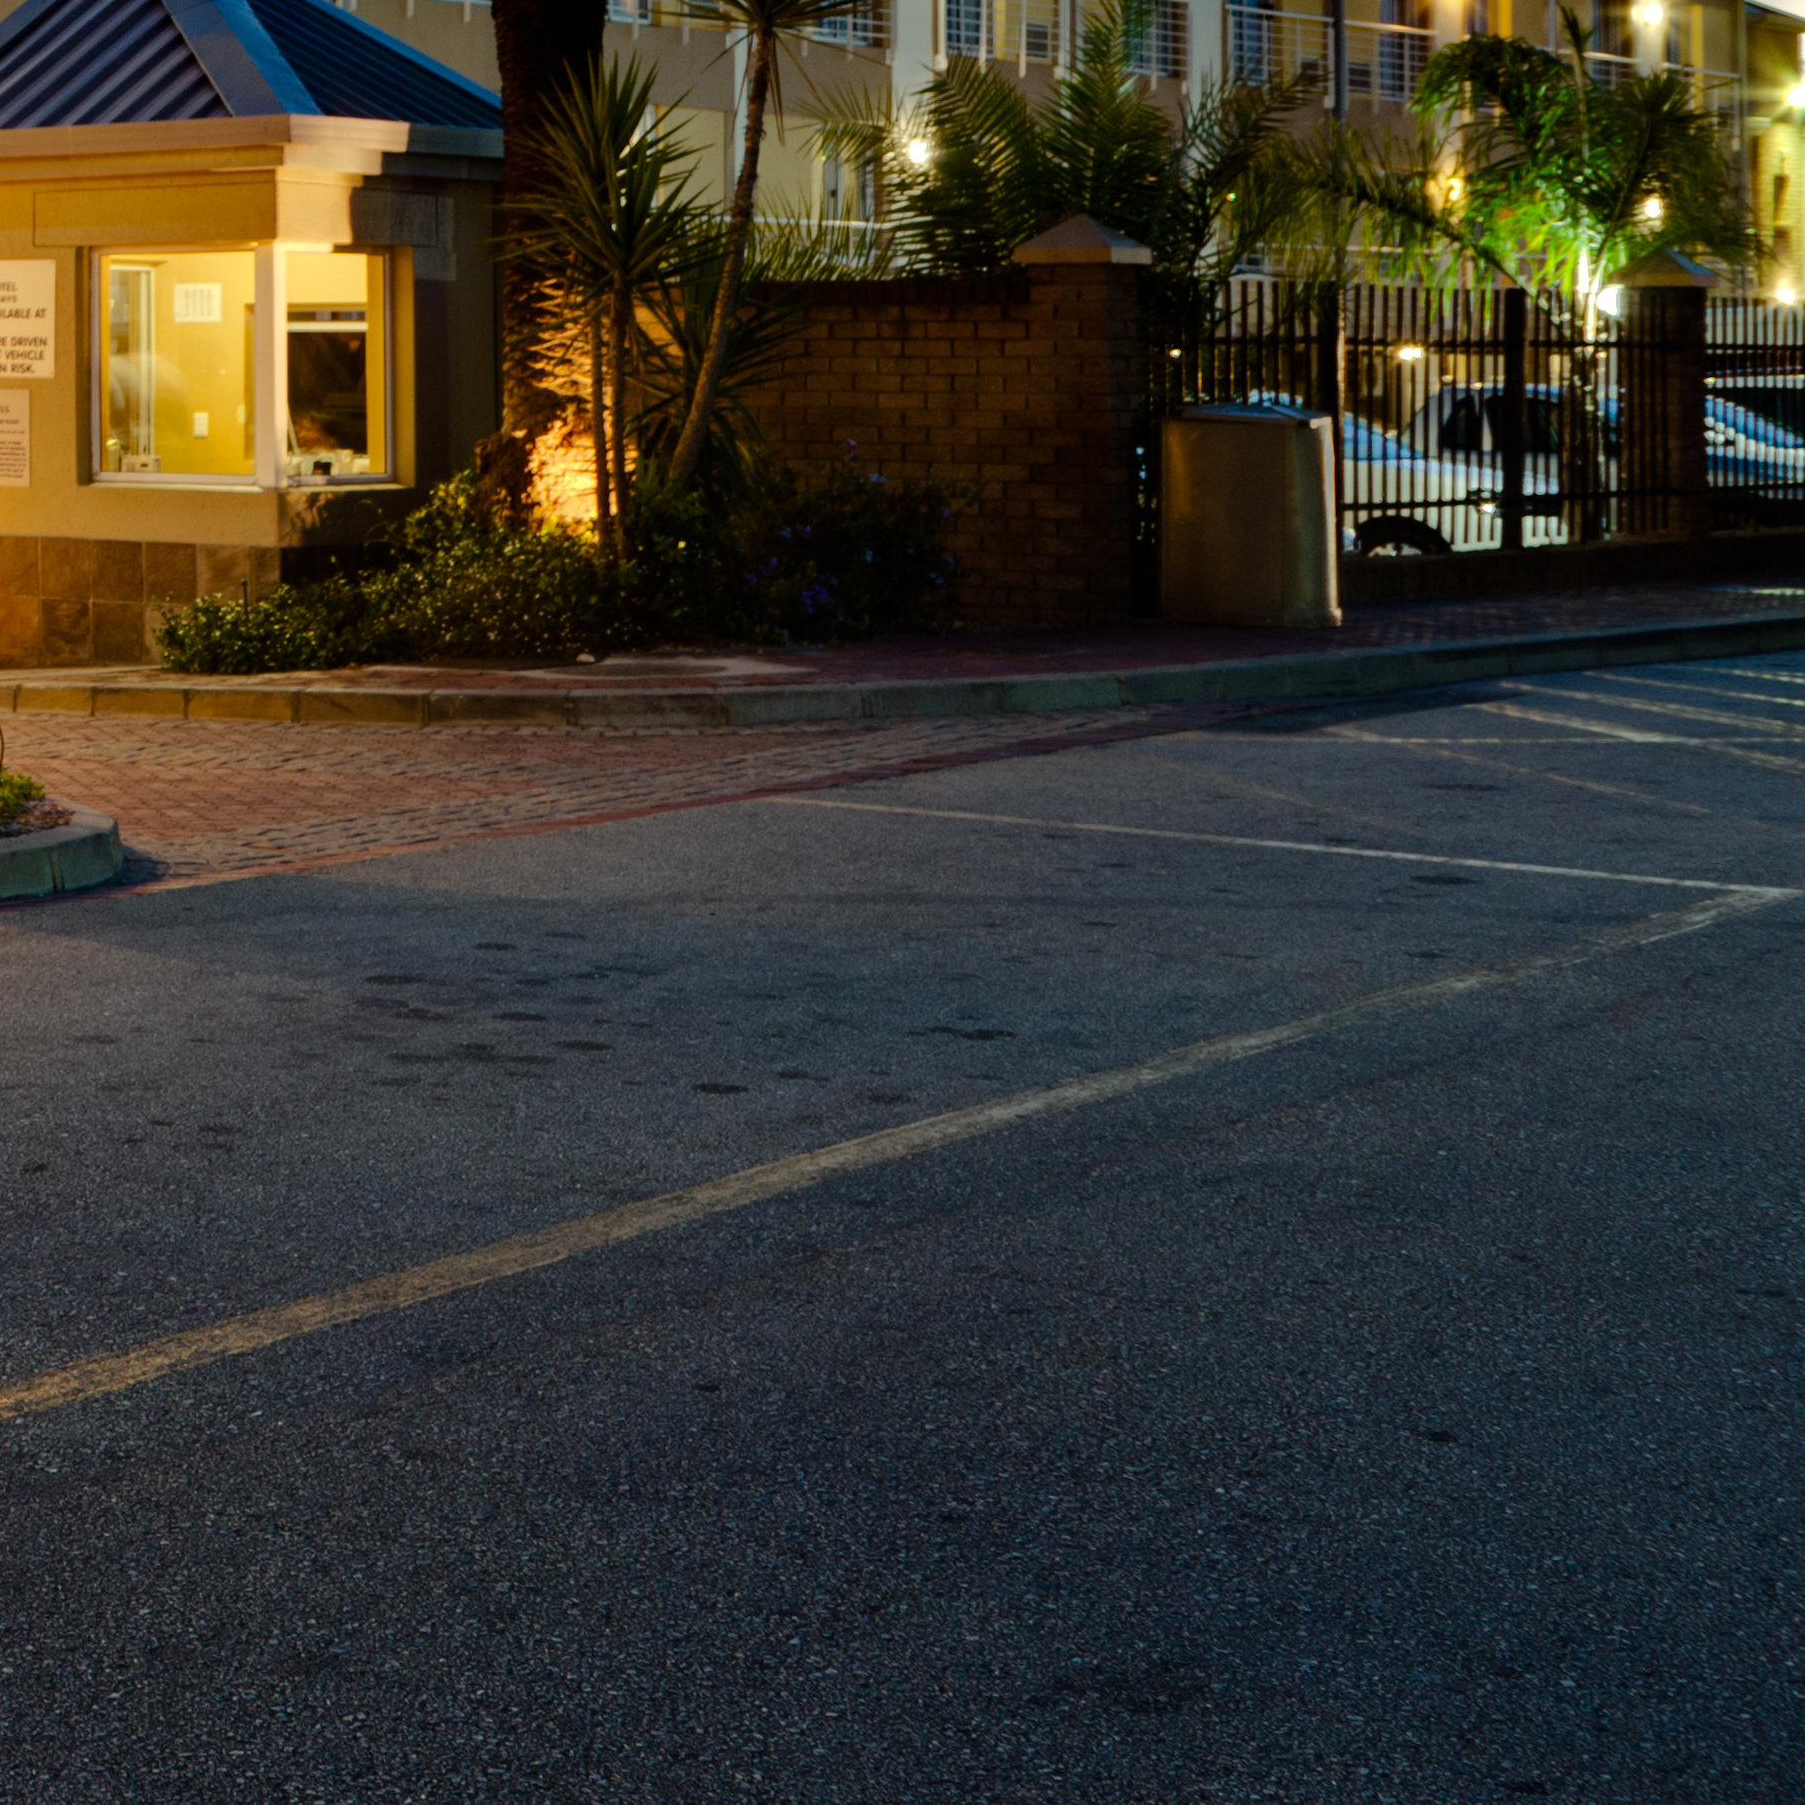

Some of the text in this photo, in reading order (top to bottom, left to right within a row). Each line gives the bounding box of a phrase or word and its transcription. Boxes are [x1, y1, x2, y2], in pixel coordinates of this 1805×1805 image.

[34, 308, 47, 318] AT
[10, 336, 48, 347] DRIVEN
[5, 349, 45, 360] VEHICLE
